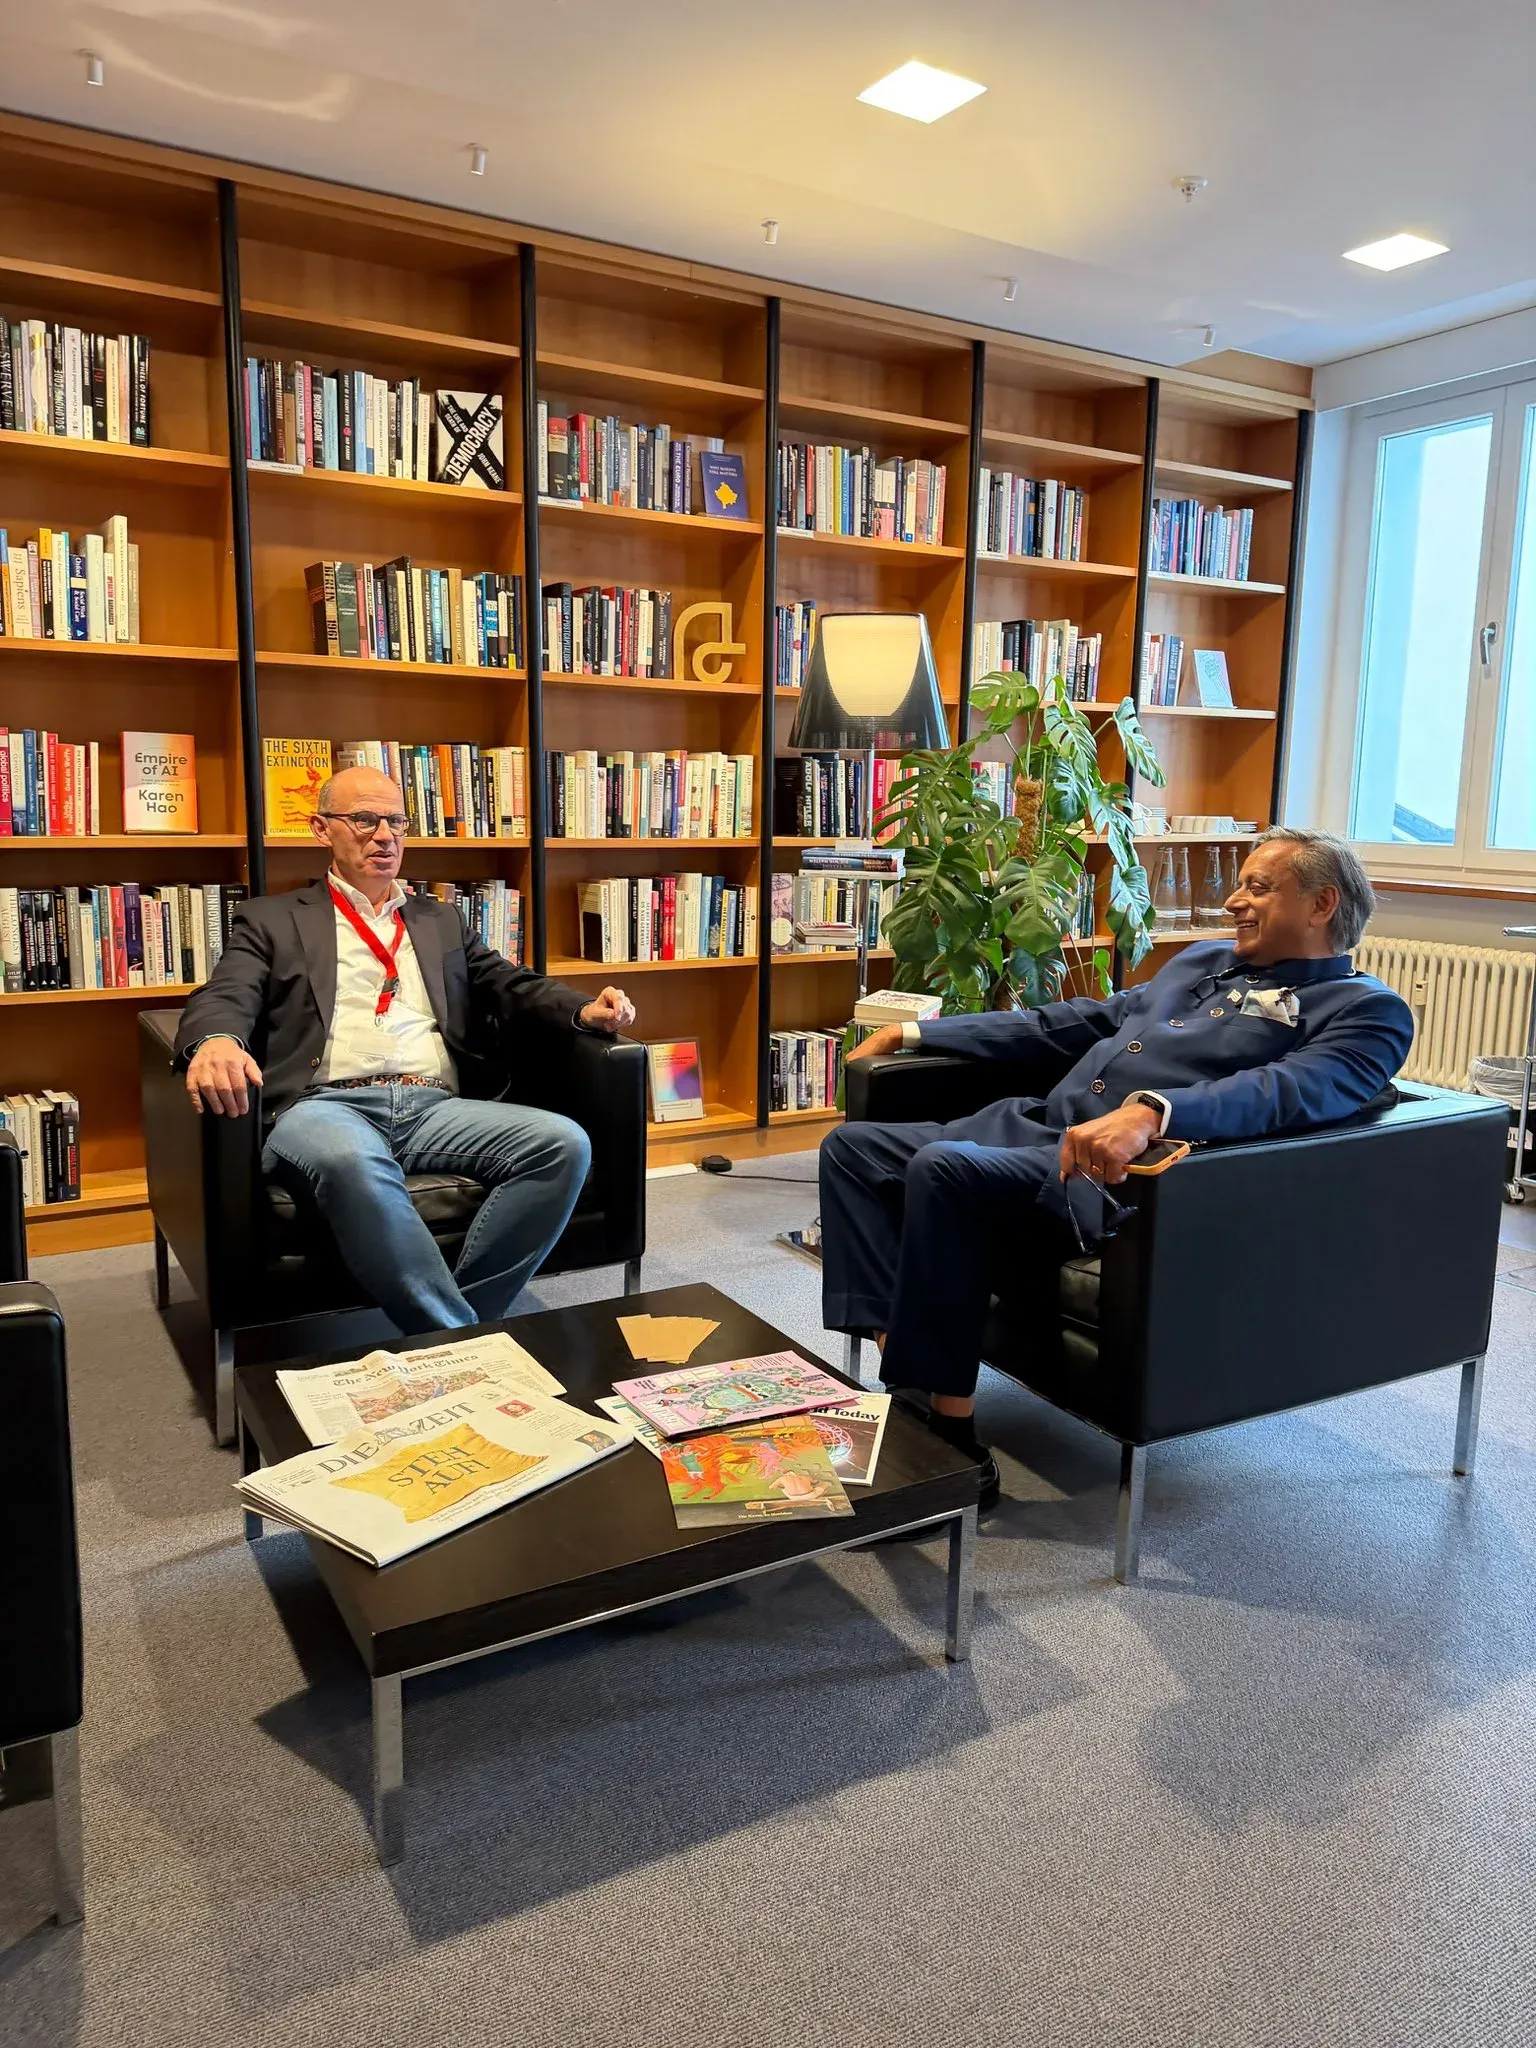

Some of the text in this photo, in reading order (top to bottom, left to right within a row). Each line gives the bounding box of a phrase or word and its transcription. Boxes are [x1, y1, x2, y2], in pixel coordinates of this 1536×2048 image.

[0, 352, 13, 407] SWERVE
[54, 369, 64, 387] CODE
[313, 393, 323, 442] BONDED LABOR
[444, 413, 461, 433] DEATH OF
[447, 404, 469, 433] THE LIFE AND
[445, 406, 497, 480] DEMOCRACY
[477, 453, 502, 484] JOHN KEANE
[74, 557, 83, 577] Oxford
[13, 568, 29, 610] Sapiens
[107, 576, 117, 625] OPERATION BARBAROSSA
[324, 566, 335, 603] BERLIN
[327, 619, 338, 641] 1961
[563, 619, 571, 663] POSTCAPITALISM
[135, 752, 188, 766] Empire
[265, 740, 328, 755] THE SIXTH
[266, 755, 328, 768] EXTINCTION
[0, 750, 9, 802] global politics
[142, 765, 178, 776] of AI
[804, 760, 812, 792] ADOLF
[138, 789, 184, 802] Karen
[146, 802, 177, 813] Hao
[0, 907, 10, 942] AUGUST
[9, 894, 20, 956] THE LONGEST
[206, 894, 220, 948] INNOVATORS
[332, 1376, 361, 1387] The
[363, 1364, 397, 1382] New
[432, 1354, 479, 1368] Times
[831, 1407, 880, 1422] Today
[317, 1401, 477, 1474] DIE ZEIT
[388, 1444, 475, 1487] STEH
[423, 1458, 491, 1496] AUF!
